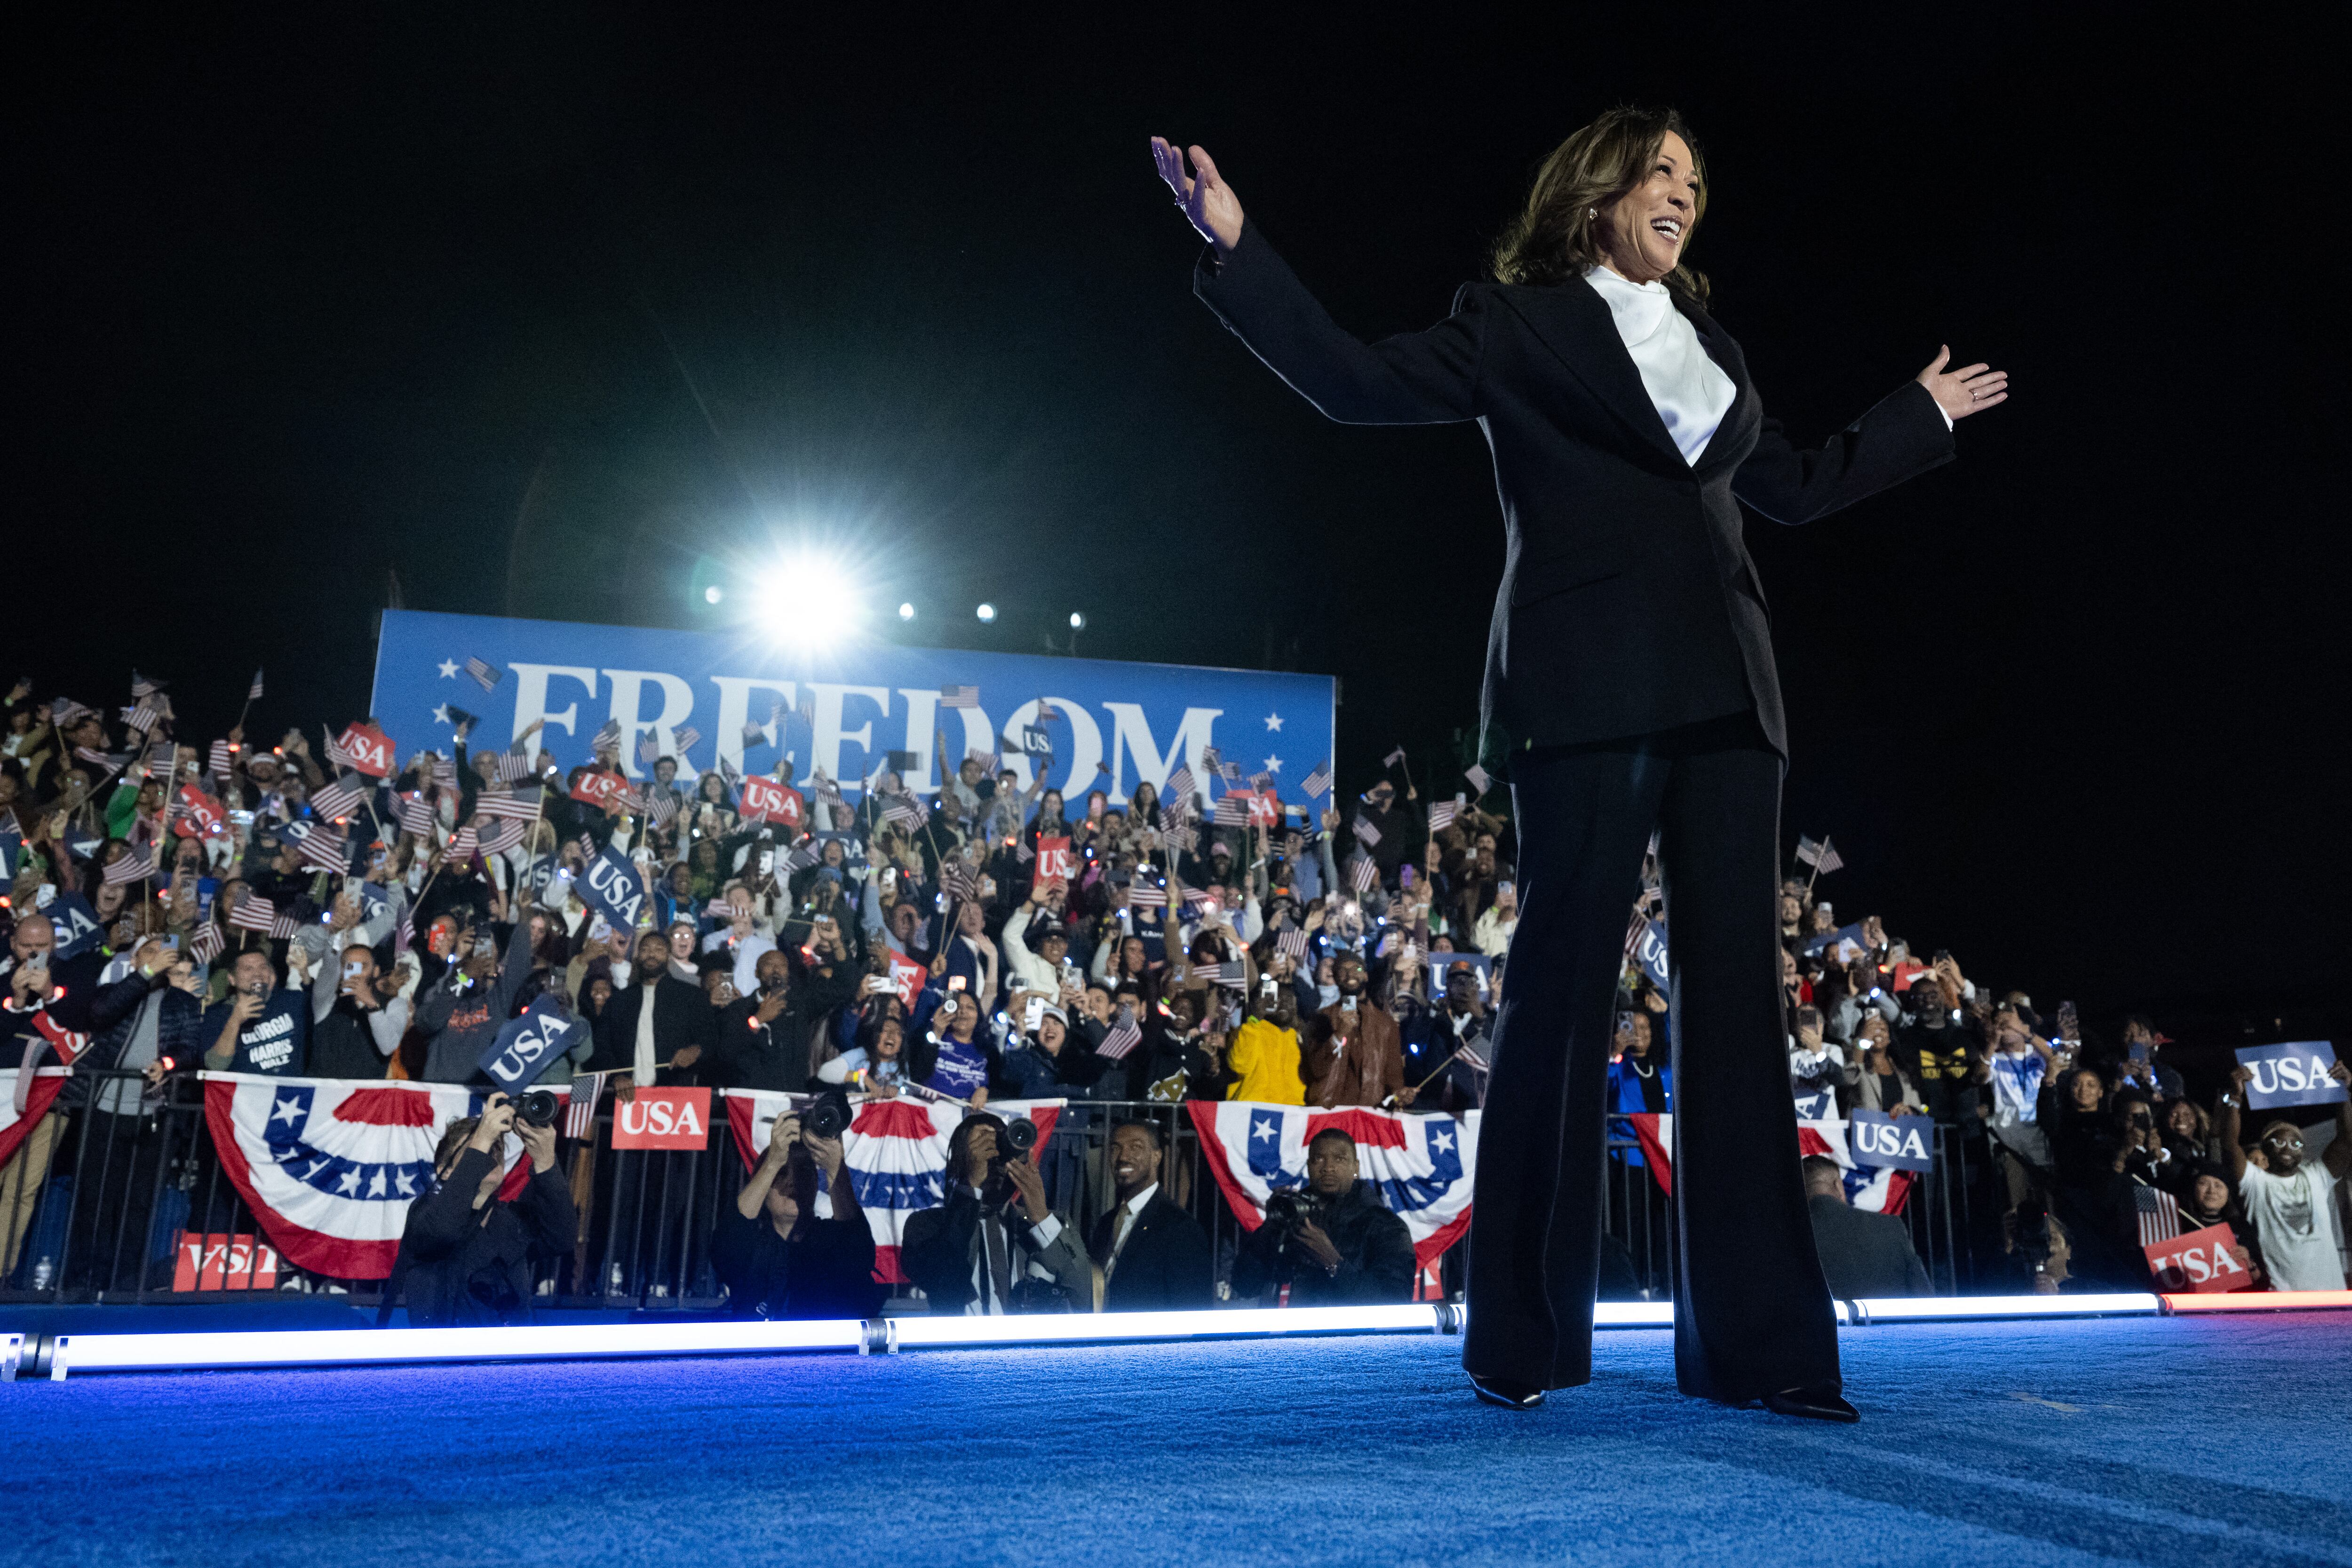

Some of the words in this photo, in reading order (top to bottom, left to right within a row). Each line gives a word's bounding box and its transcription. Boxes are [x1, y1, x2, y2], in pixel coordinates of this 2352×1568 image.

[340, 730, 385, 769] USA
[508, 662, 1224, 810] FREEDOM
[1025, 730, 1052, 753] US
[747, 783, 798, 818] USA
[1247, 797, 1275, 817] SA
[1040, 849, 1066, 877] US
[589, 855, 643, 926] USA
[489, 1014, 571, 1081] USA
[2243, 1055, 2341, 1094] USA
[621, 1100, 704, 1135] USA
[1855, 1121, 1930, 1160] USA
[2152, 1242, 2243, 1290] USA
